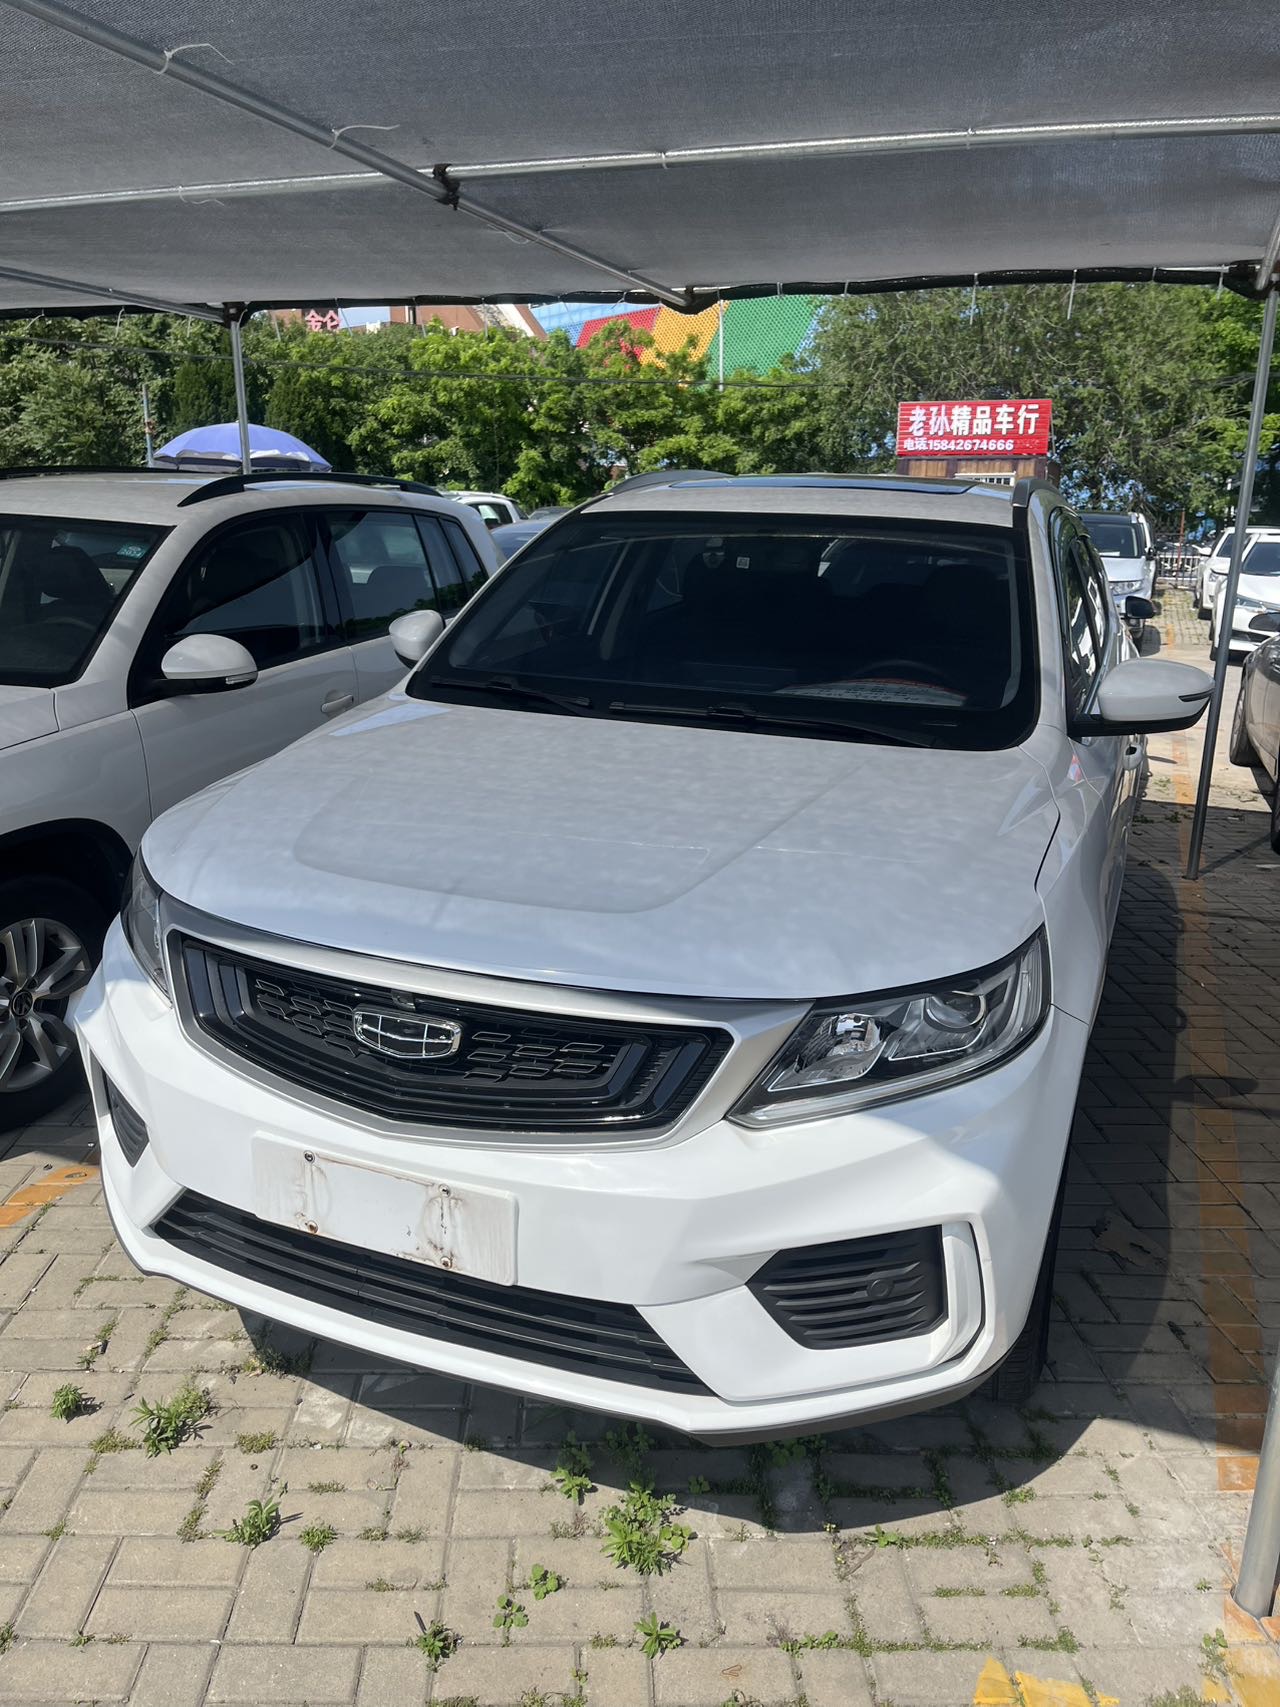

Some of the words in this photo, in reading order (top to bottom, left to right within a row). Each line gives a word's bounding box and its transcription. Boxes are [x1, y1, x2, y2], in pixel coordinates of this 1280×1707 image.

[909, 403, 1039, 436] 老孙精品车行
